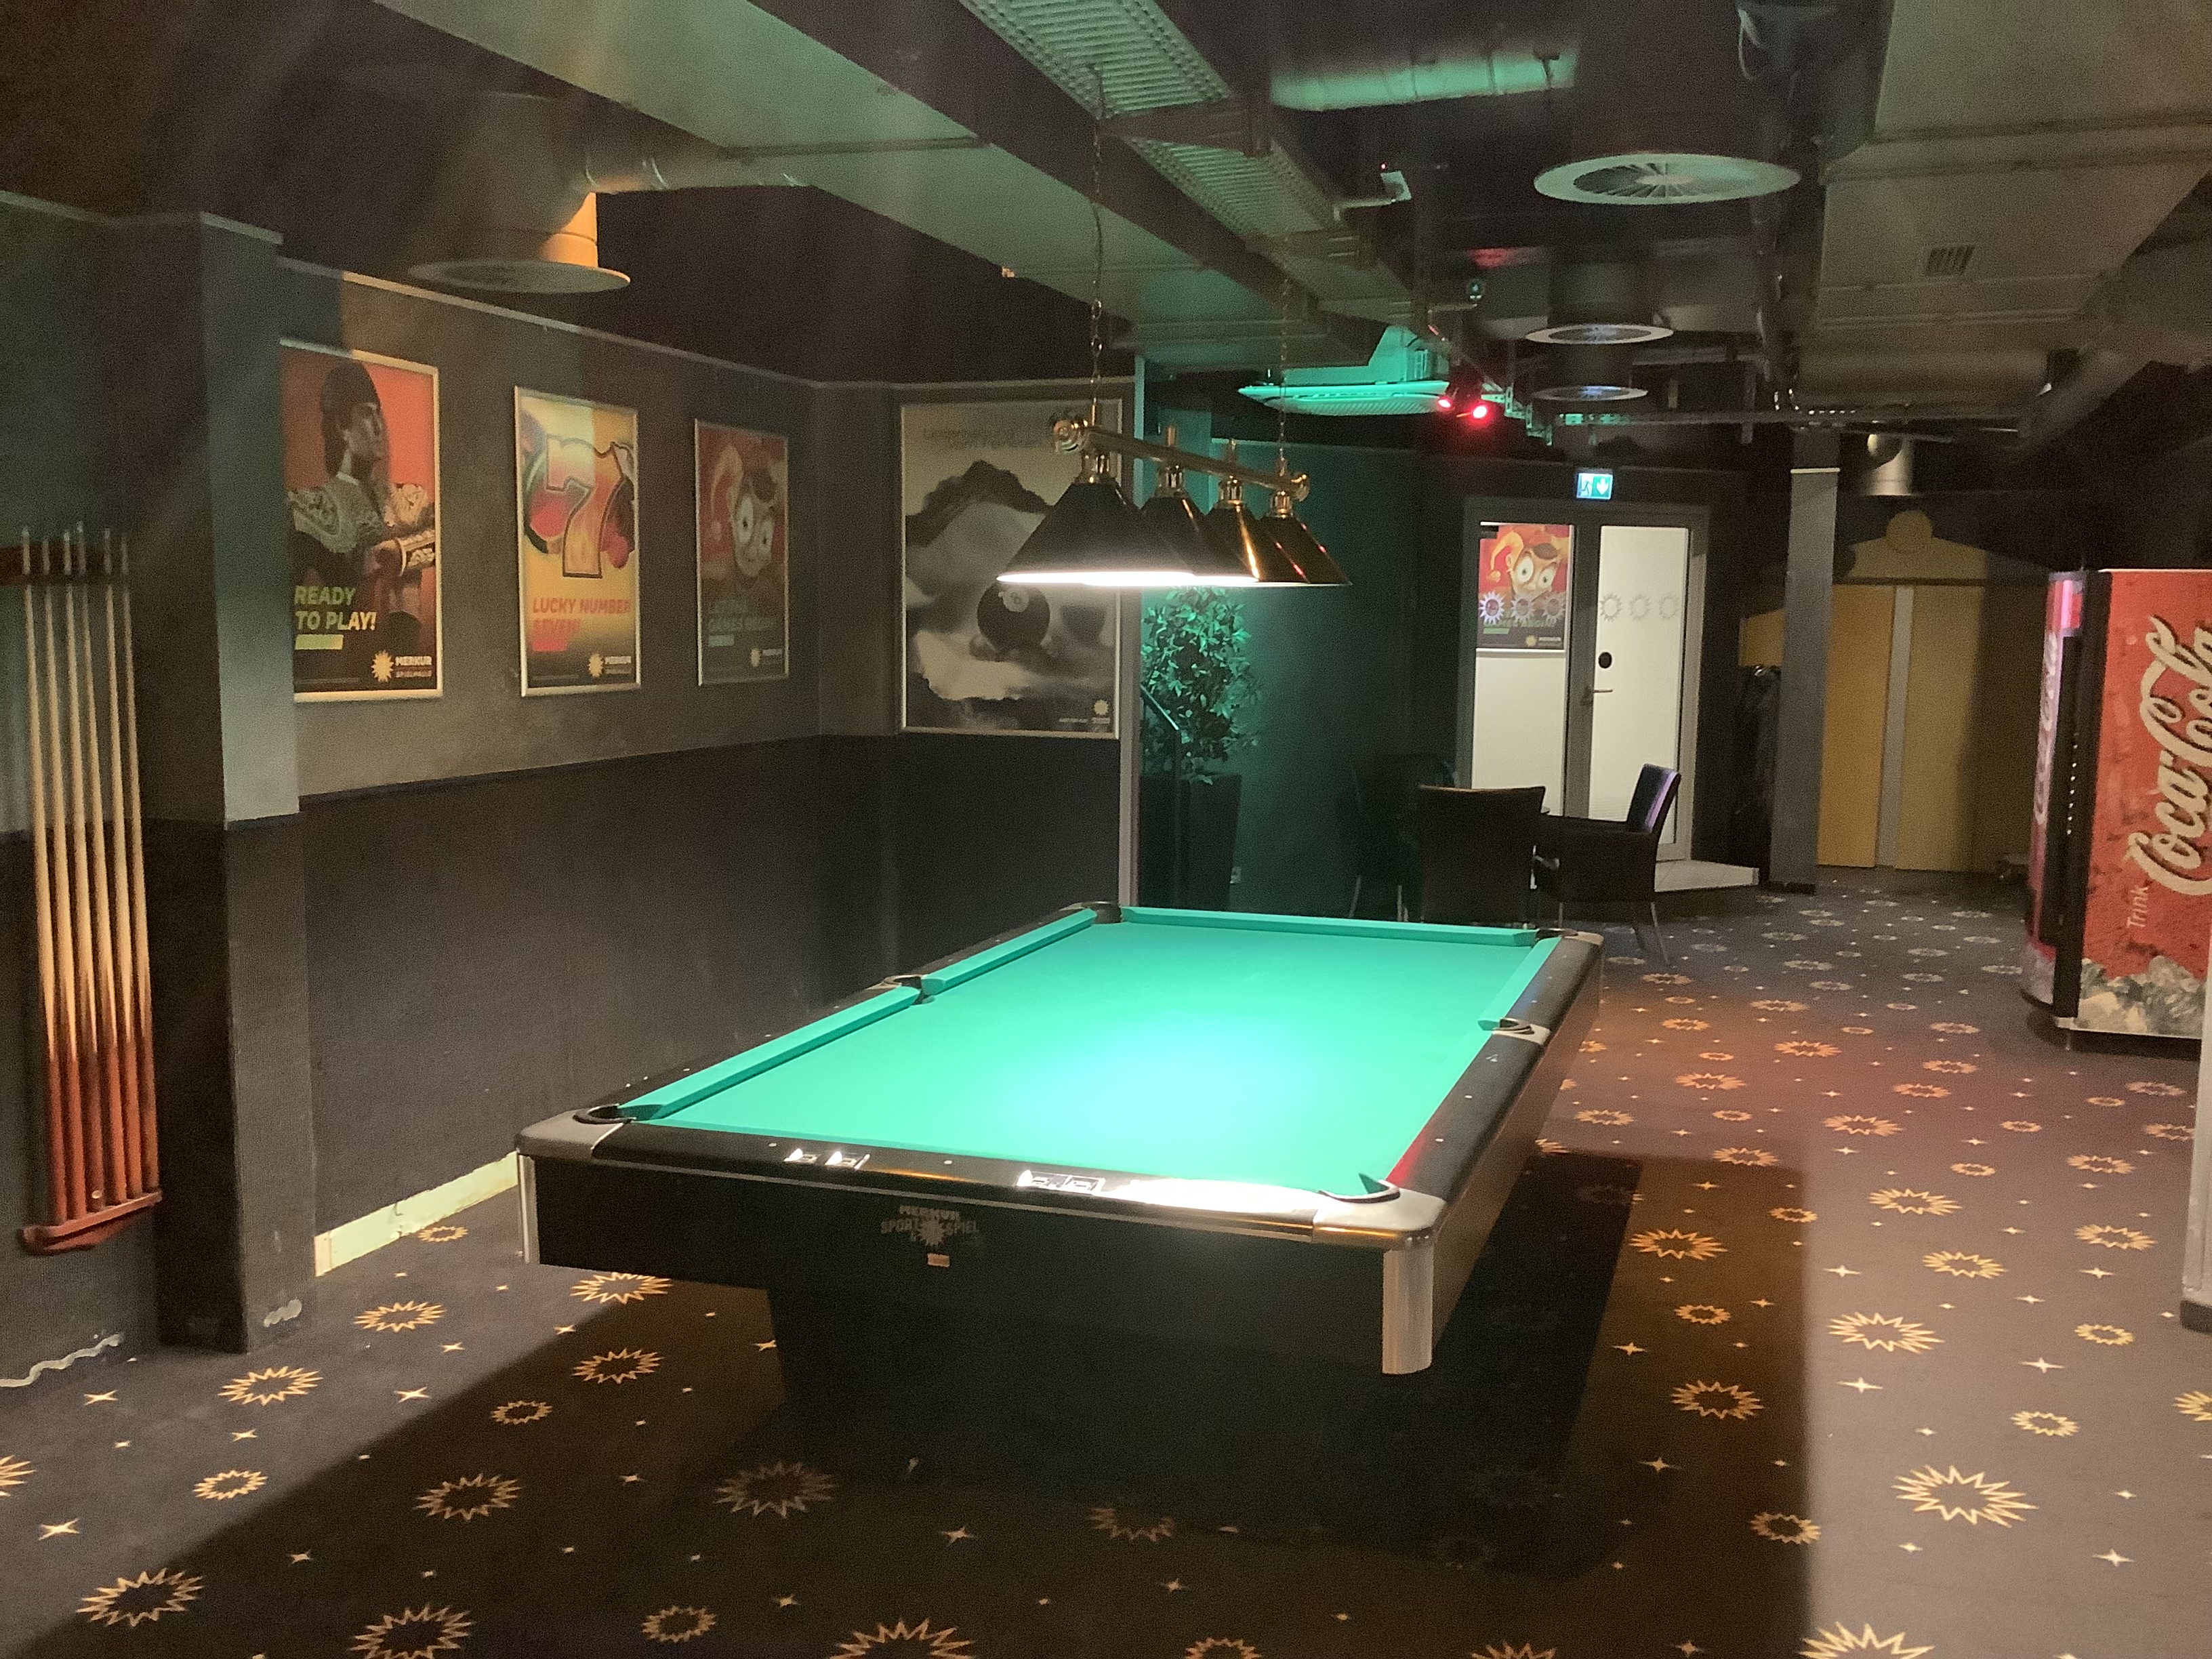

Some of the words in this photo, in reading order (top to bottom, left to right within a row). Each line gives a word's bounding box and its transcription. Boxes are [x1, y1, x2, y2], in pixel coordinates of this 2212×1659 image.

[294, 586, 356, 605] READY
[533, 598, 577, 613] LUCKY
[579, 599, 631, 615] NUMBER
[295, 611, 321, 630] TO
[325, 611, 377, 631] PLAY!
[2126, 886, 2150, 928] Trink
[880, 1217, 920, 1234] SPORT
